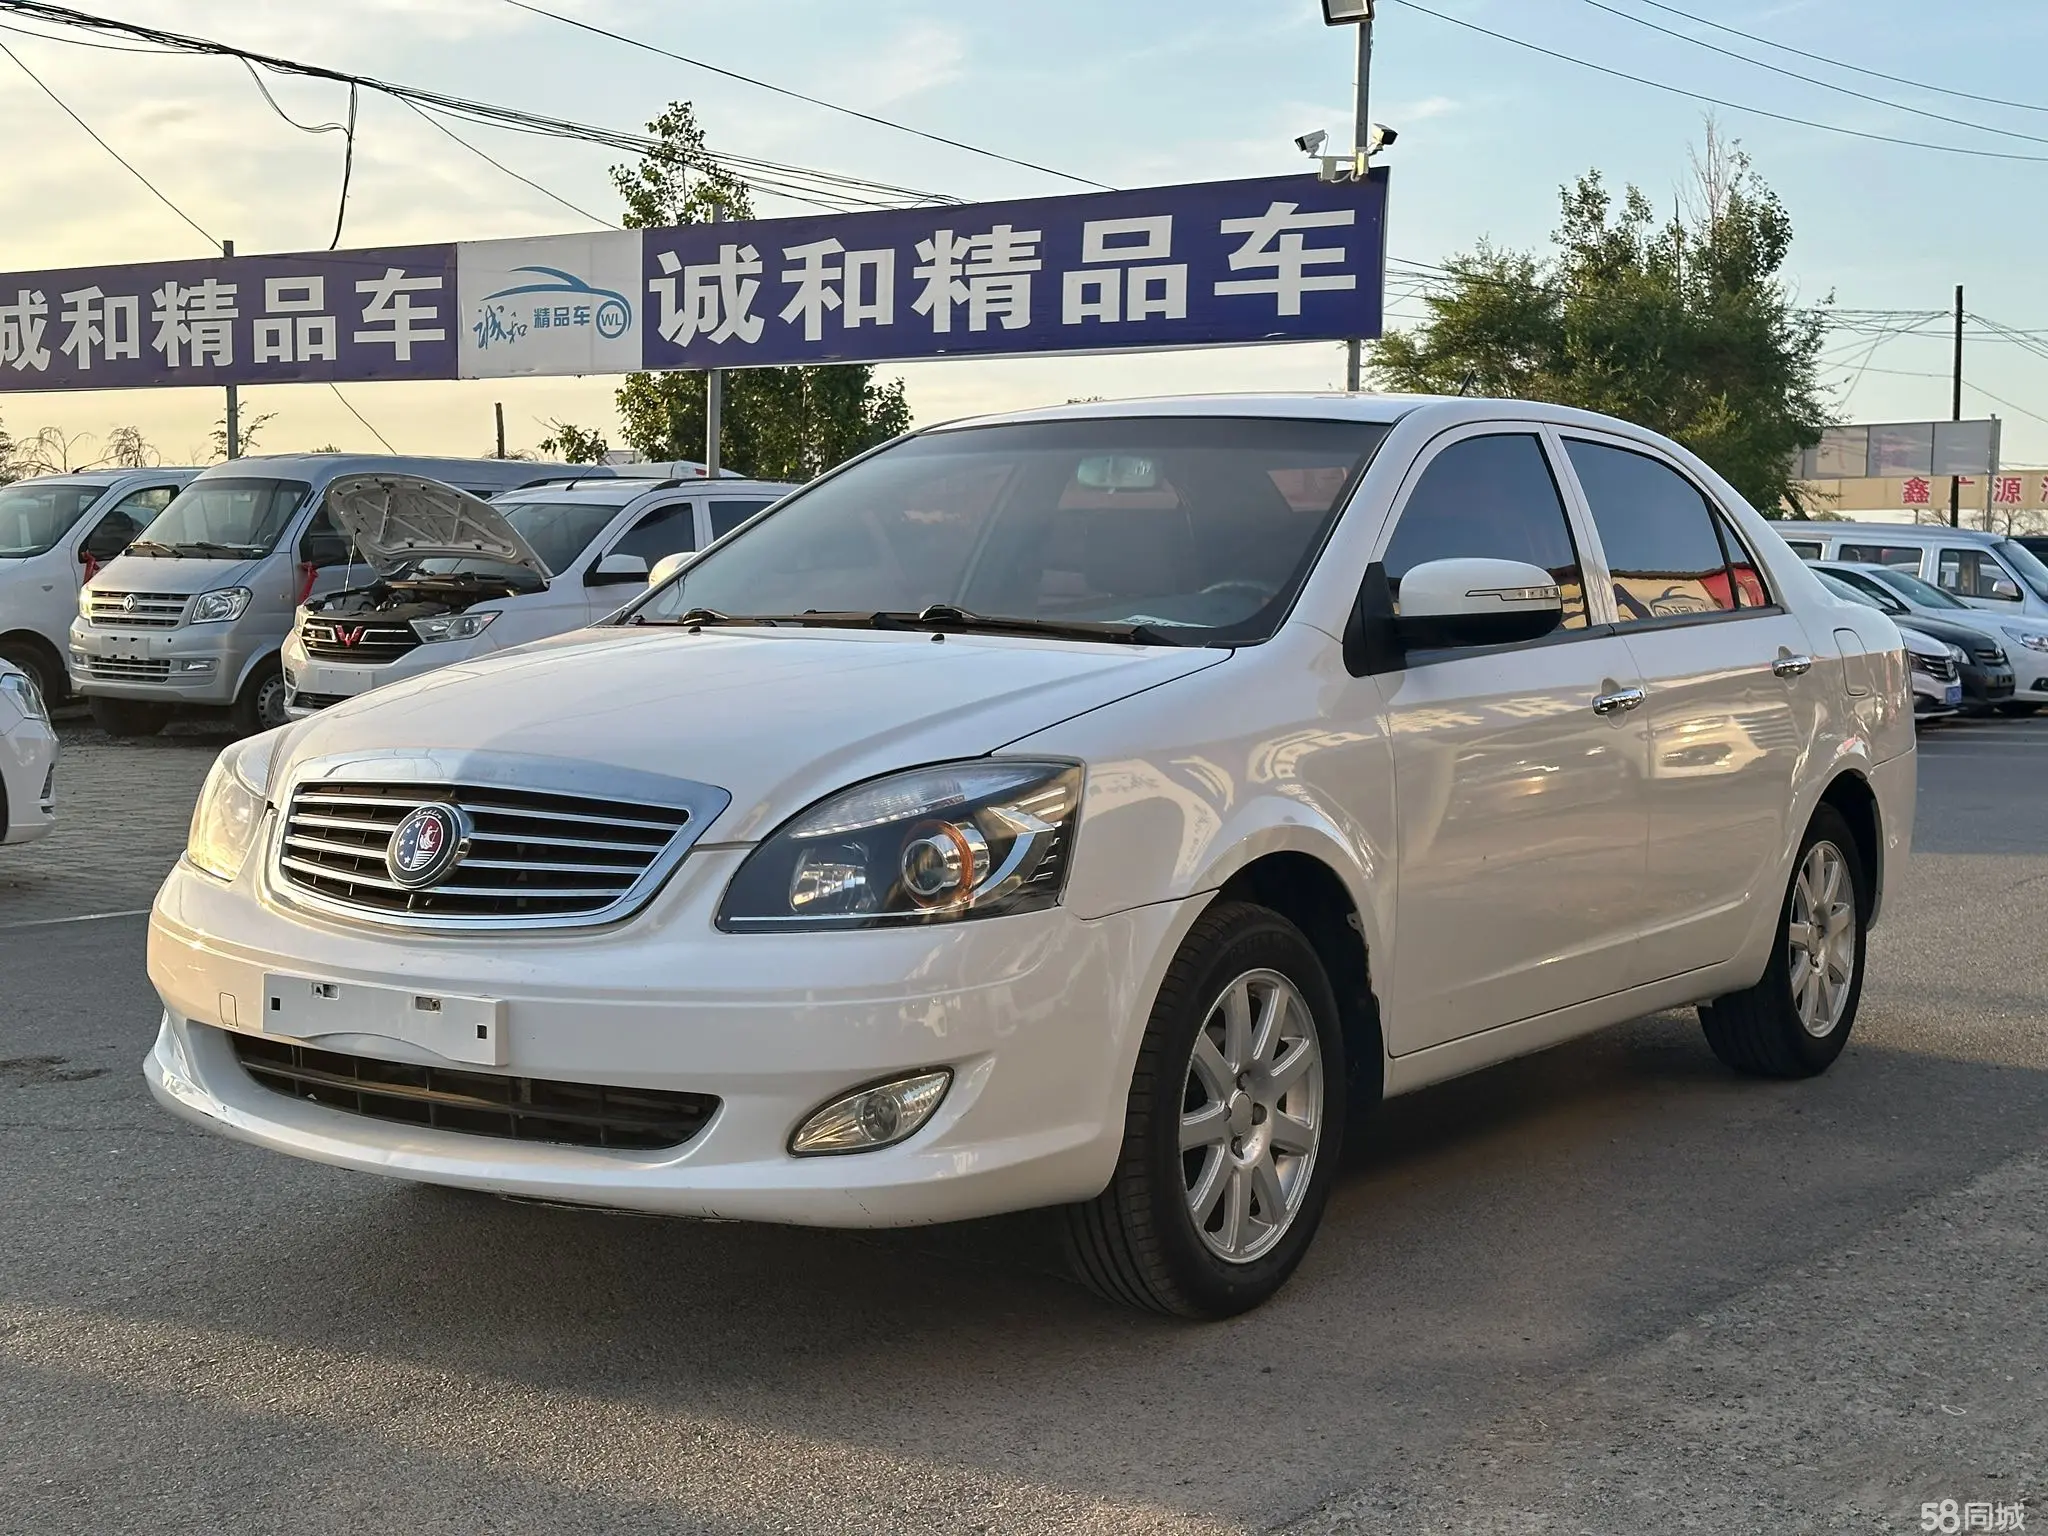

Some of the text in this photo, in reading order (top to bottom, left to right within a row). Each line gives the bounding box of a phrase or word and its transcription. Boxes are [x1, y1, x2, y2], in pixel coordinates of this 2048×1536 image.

[649, 202, 1357, 348] 诚和精品车
[472, 304, 591, 350] 诚和 精品车
[601, 312, 623, 327] WL
